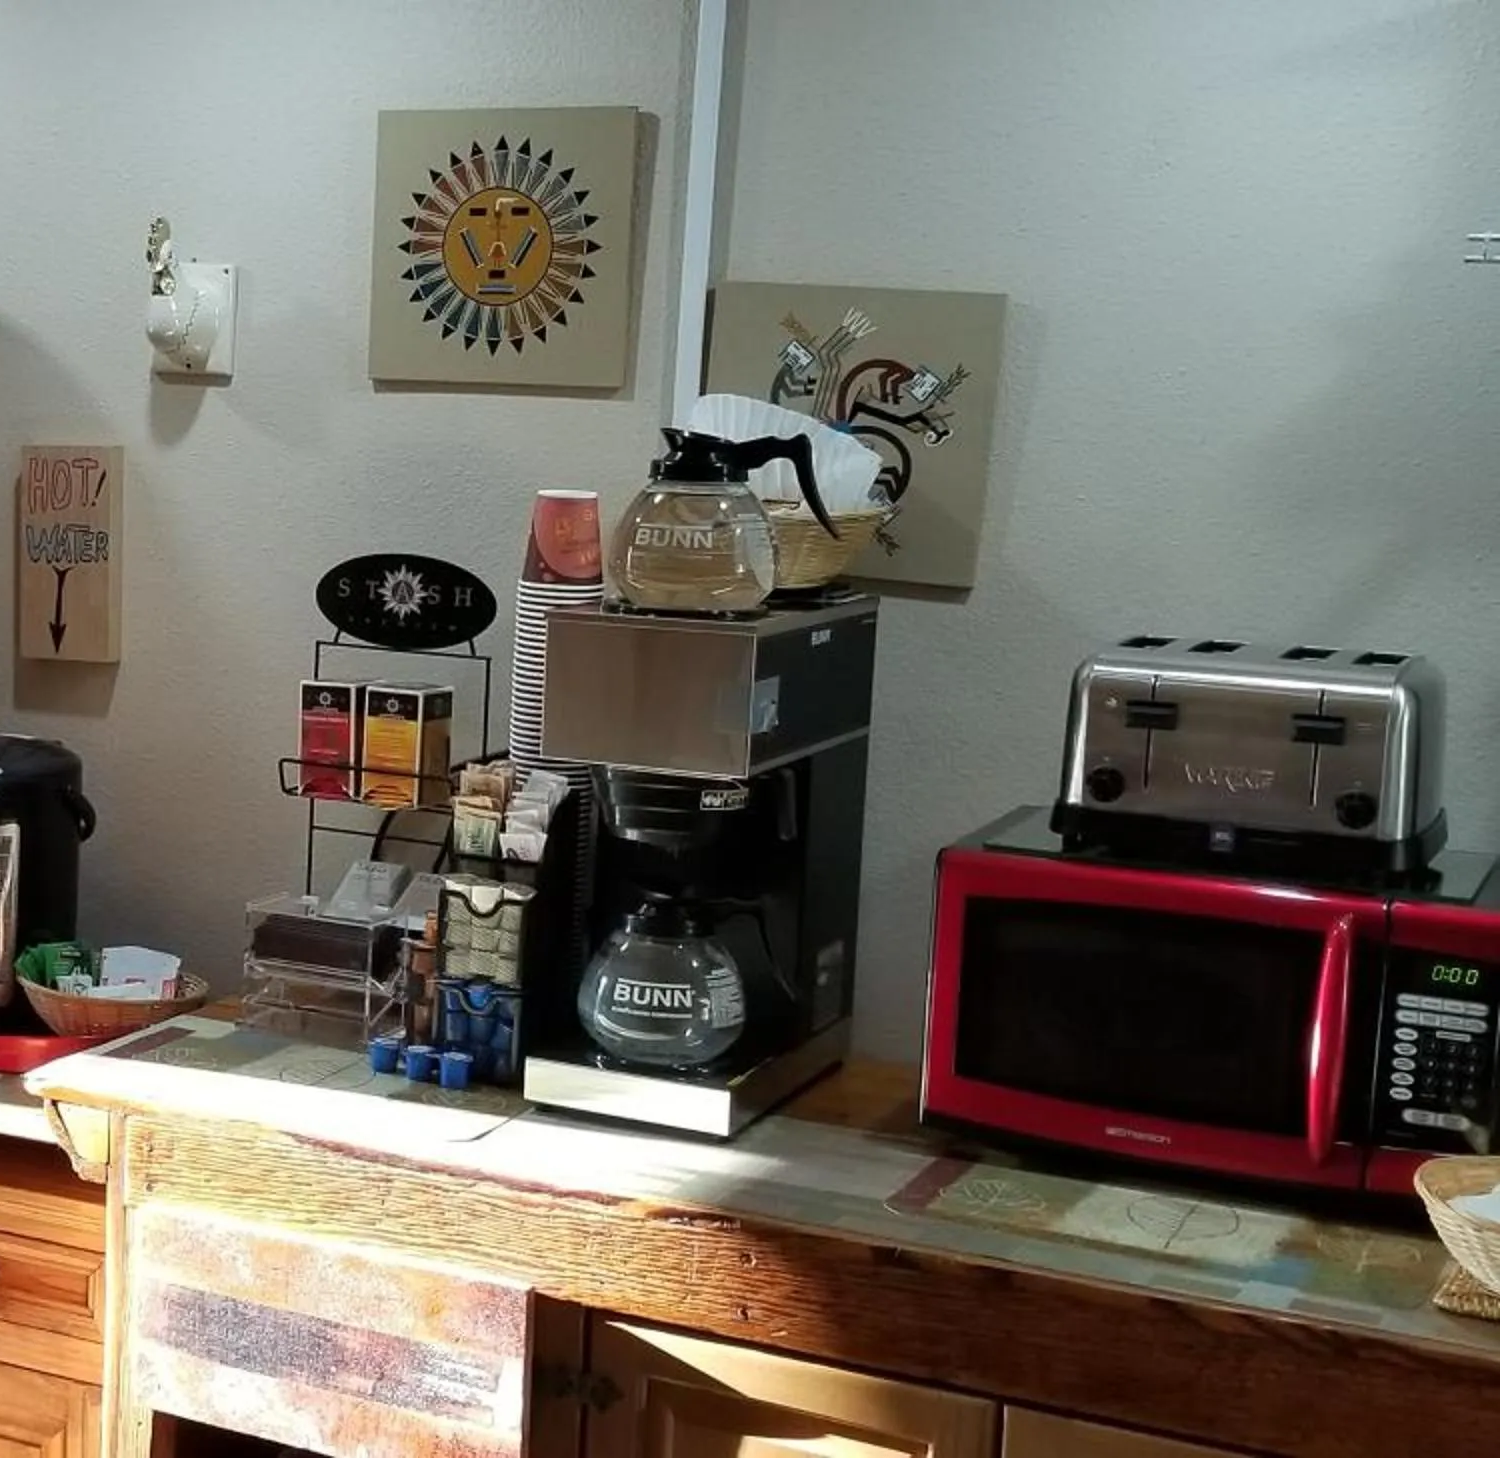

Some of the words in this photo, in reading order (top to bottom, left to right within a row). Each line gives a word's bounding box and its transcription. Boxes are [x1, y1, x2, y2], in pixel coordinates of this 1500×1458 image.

[28, 457, 108, 513] HOT!
[25, 522, 110, 564] WATER
[634, 527, 714, 549] BUNN
[337, 576, 473, 608] STASH
[1431, 964, 1480, 986] 0:00
[613, 982, 694, 1008] BUNN
